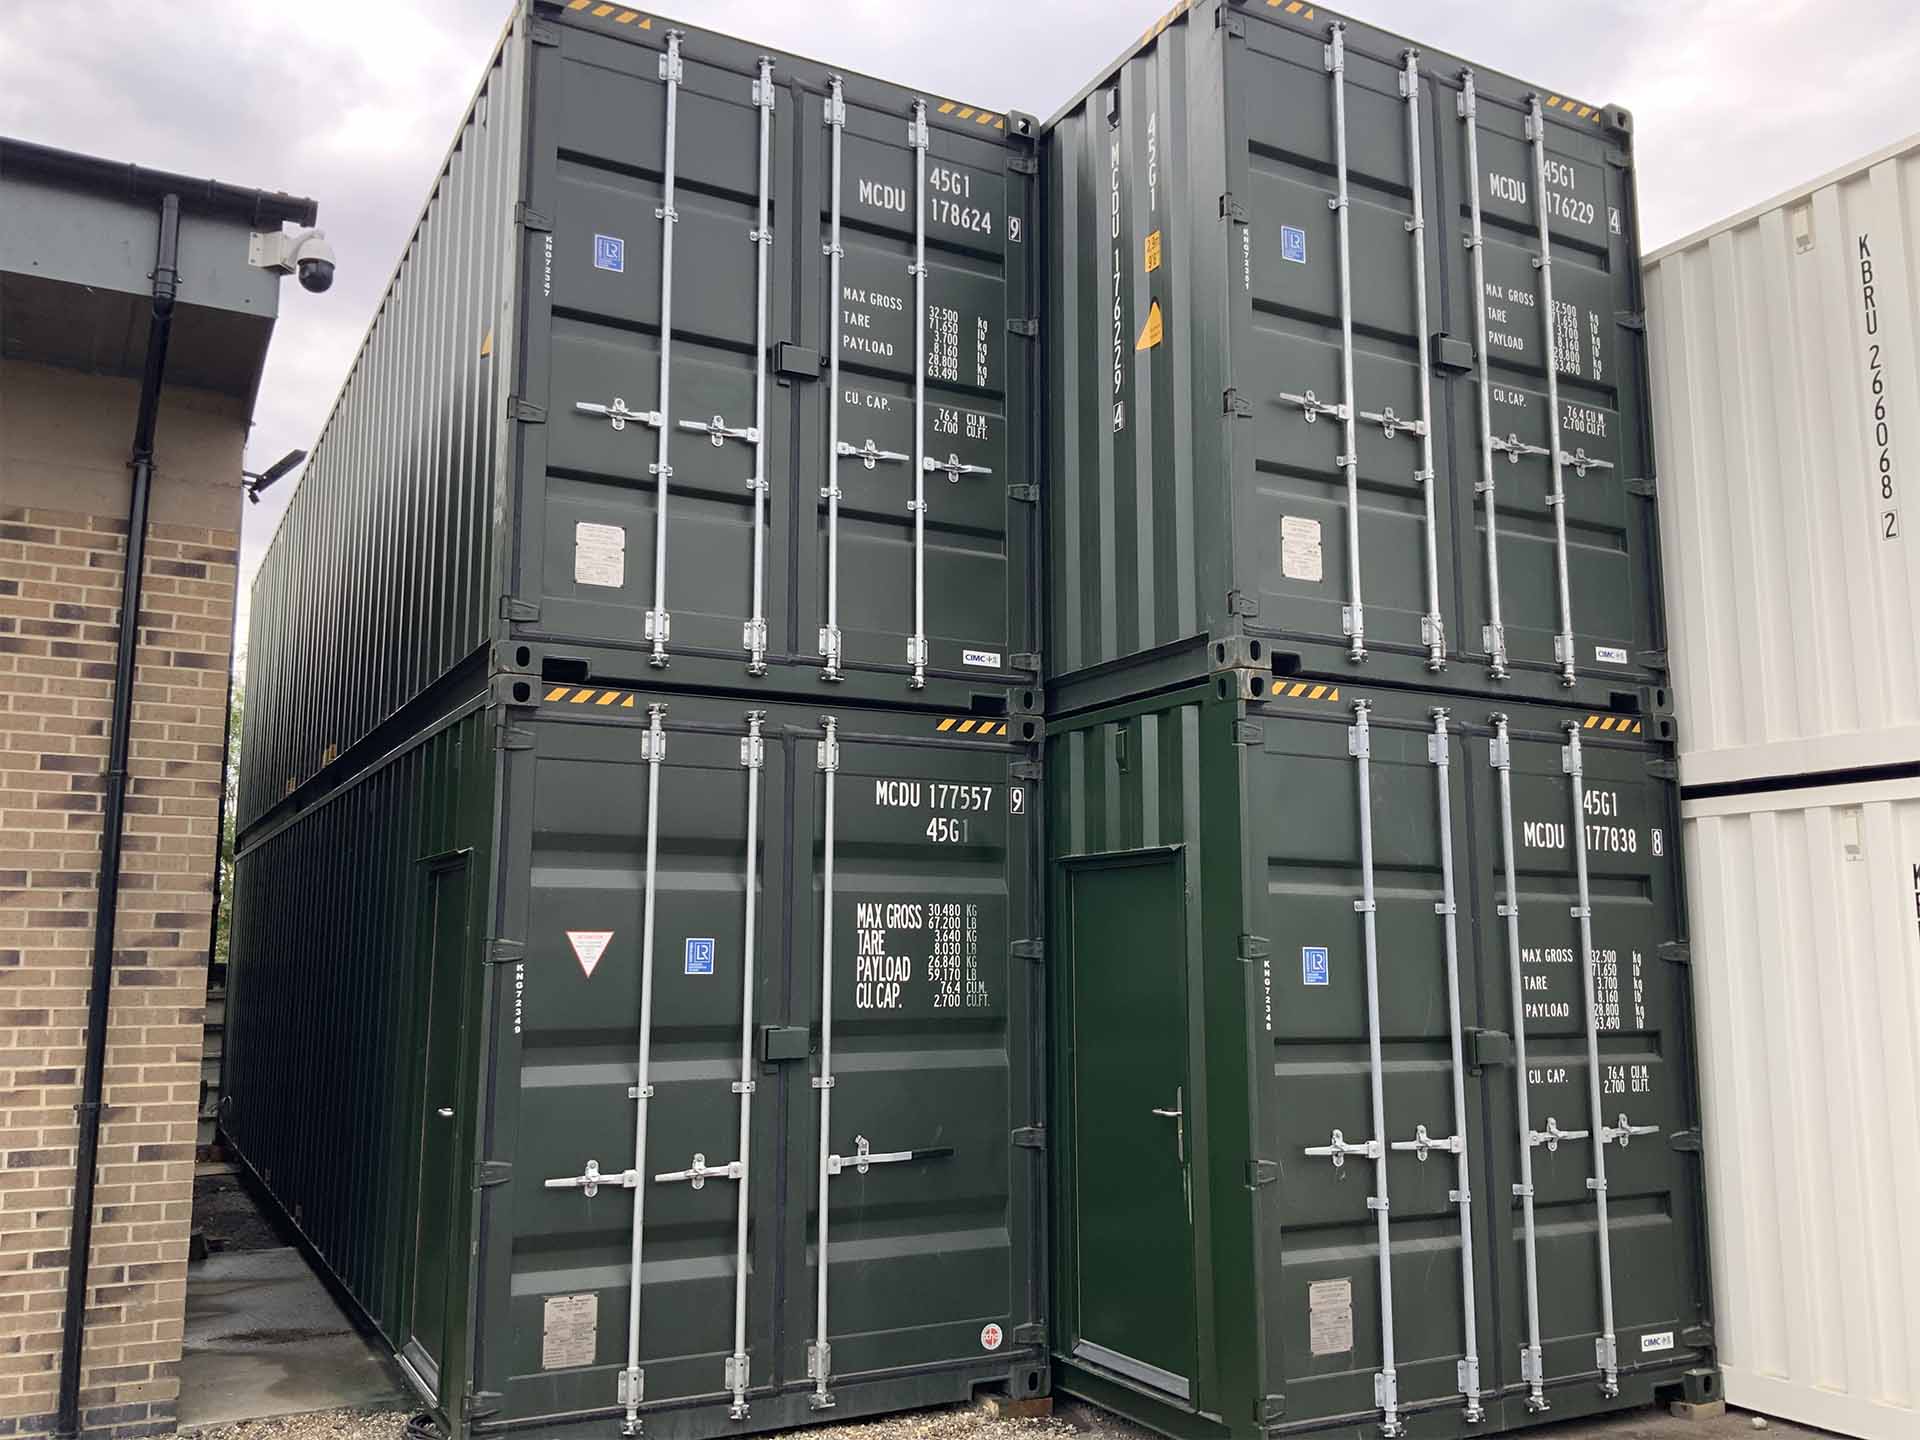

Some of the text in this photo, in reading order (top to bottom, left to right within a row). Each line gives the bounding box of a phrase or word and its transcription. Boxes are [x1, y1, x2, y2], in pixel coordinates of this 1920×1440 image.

[1148, 112, 1156, 212] 45G1
[930, 167, 970, 198] 45G1
[1543, 160, 1574, 190] 45G1
[1112, 141, 1120, 239] MCDU
[859, 179, 1020, 241] MCDU 178624 9
[1490, 172, 1620, 234] MCDU 176229 4
[844, 287, 988, 333] MAX GROSS 32.500 kg
[1486, 283, 1503, 299] MAX
[1508, 289, 1535, 307] GROSS
[1589, 310, 1599, 327] kg
[844, 311, 988, 356] TARE 3.700 kg
[928, 317, 986, 341] 71.650 lb
[1114, 248, 1122, 394] 176229
[1488, 307, 1600, 350] TARE 3.700 kg
[934, 342, 986, 364] 8.160 lb
[1488, 330, 1524, 350] PAYLOAD
[1593, 357, 1602, 373] kg
[1558, 336, 1580, 352] 8.160
[844, 335, 988, 379] PAYLOAD 28.800 kg
[928, 365, 986, 387] 63.490 lb
[1859, 234, 1898, 539] KBRU 266068 2
[845, 391, 862, 406] CU.
[867, 395, 892, 412] CAP.
[939, 408, 959, 423] 76.4
[1494, 388, 1507, 403] CU.
[1508, 392, 1527, 408] CAP.
[934, 419, 958, 434] 2.700
[1562, 417, 1584, 432] 2.700
[965, 654, 986, 663] CIMC
[876, 780, 1023, 812] MCDU 177557 9
[1584, 790, 1617, 816] 45G1
[926, 817, 969, 843] 45G1
[1524, 821, 1662, 855] MCDU 177838 8
[857, 903, 977, 928] MAX GROSS 30.480 KG
[928, 916, 977, 929] 67.200 LB
[857, 930, 977, 955] TARE 3.640 KG
[934, 942, 976, 955] 8.030 LB
[856, 956, 977, 982] PAYLOAD 26.840 KG
[1522, 949, 1642, 966] MAX GROSS 32.500 kg
[1592, 964, 1640, 976] 71.650 lb
[928, 968, 976, 981] 59.170 LB
[1524, 976, 1643, 992] TARE 3.700 kg
[856, 981, 987, 1008] CU. CAP. 76.4 CU.M.
[934, 994, 990, 1008] 2.700 CU.FT.
[1598, 990, 1618, 1003] 8.160
[1526, 1003, 1644, 1019] PAYLOAD 28.800 kg
[1594, 1017, 1644, 1030] 63.490 lb
[1528, 1070, 1544, 1084] CU.
[1547, 1069, 1568, 1083] CAP.
[1608, 1066, 1624, 1080] 76.4
[1604, 1080, 1625, 1094] 2.700
